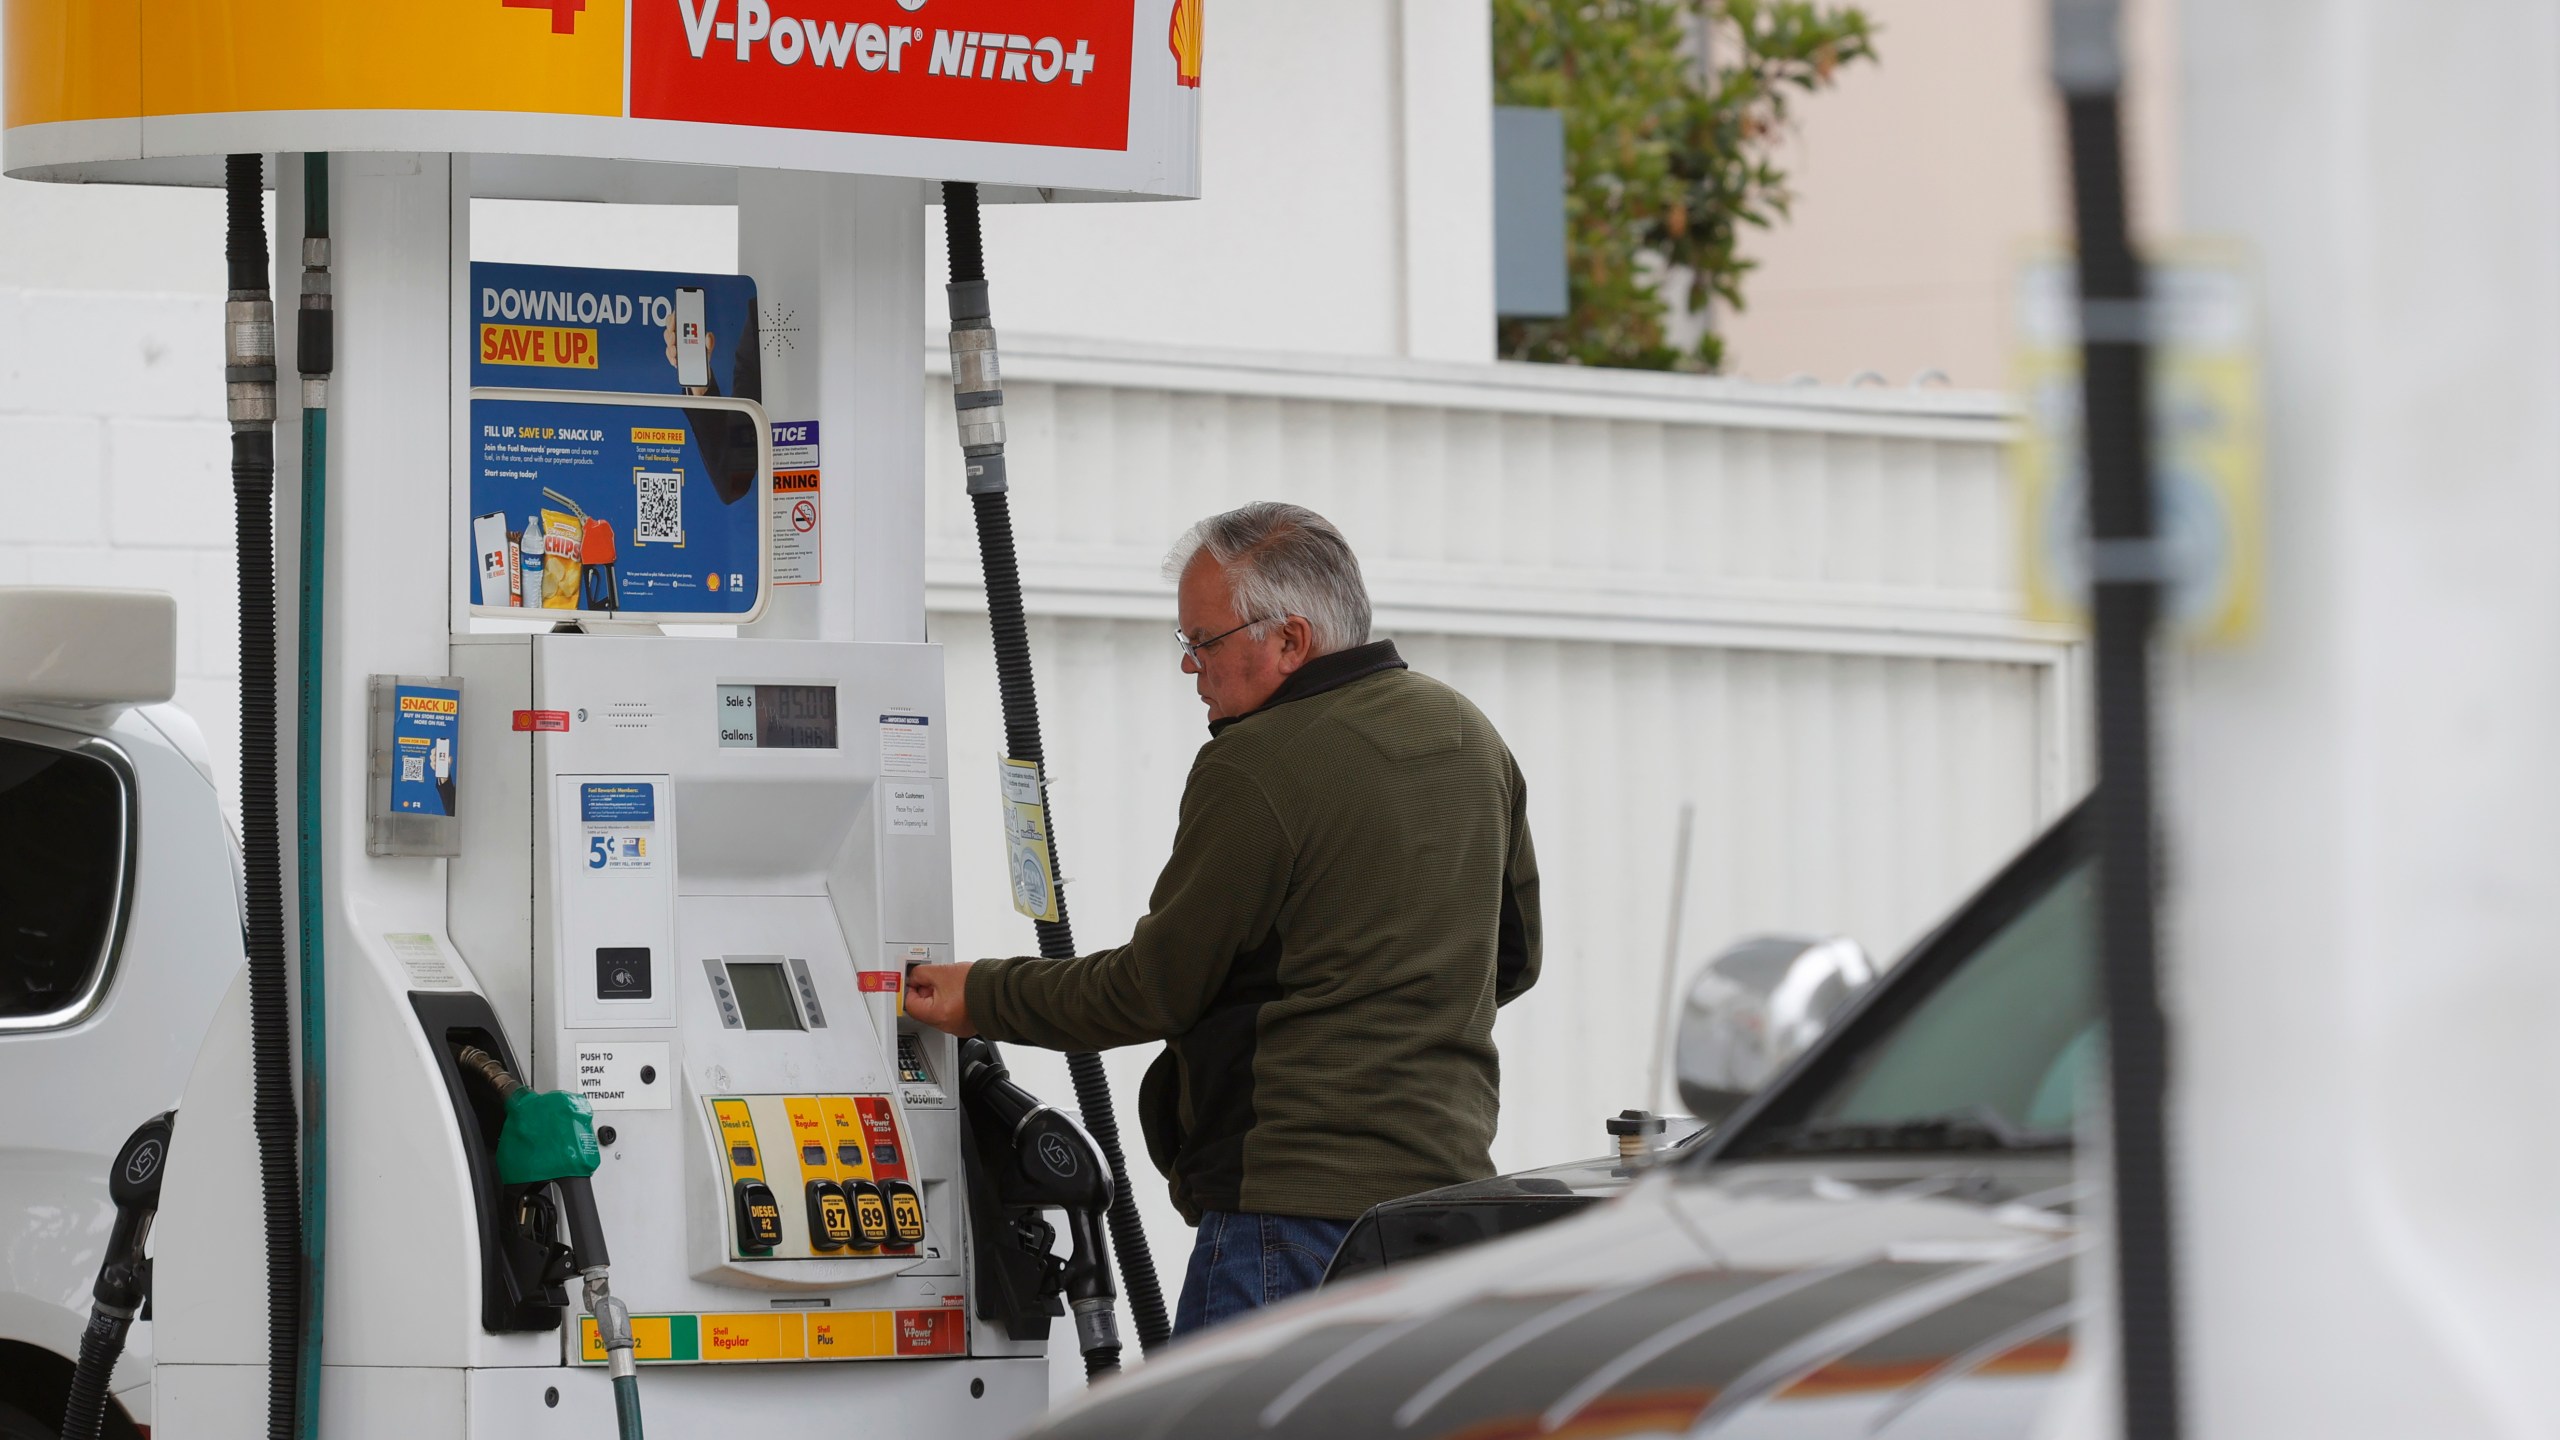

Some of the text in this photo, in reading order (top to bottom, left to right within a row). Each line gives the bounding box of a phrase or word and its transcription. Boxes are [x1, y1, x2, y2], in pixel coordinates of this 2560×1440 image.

[482, 287, 672, 327] DOWNLOAD TO
[483, 327, 595, 366] SAVE UP.
[484, 425, 605, 441] FILL UP. SAVE UP. SNACK UP.
[634, 431, 683, 441] JOIN FOR FREE
[772, 427, 807, 442] TICE
[484, 444, 497, 452] Join
[497, 443, 506, 452] the
[507, 444, 520, 453] Fuel
[546, 447, 571, 456] program
[571, 447, 581, 455] and
[501, 453, 509, 461] the
[533, 455, 544, 463] with
[553, 457, 573, 466] payment
[484, 468, 538, 480] Start saving today!
[773, 474, 818, 490] RNING
[545, 536, 581, 560] CHIPS
[510, 545, 520, 574] CANDY
[511, 573, 521, 590] BAR
[402, 698, 456, 713] SNACK UP.
[726, 695, 752, 709] Sale $
[721, 729, 754, 741] Gallons
[895, 791, 925, 800] Cash Customers
[895, 805, 907, 813] Please
[580, 1053, 613, 1061] PUSH TO
[581, 1066, 605, 1074] SPEAK
[583, 1091, 625, 1099] ATTENDANT
[722, 1120, 741, 1128] Diesel
[795, 1120, 819, 1129] Regular
[864, 1119, 890, 1127] V-Power
[1043, 1138, 1070, 1169] VST
[130, 1147, 156, 1178] VST
[751, 1205, 778, 1218] DIESEL
[861, 1207, 883, 1228] 89
[895, 1207, 919, 1228] 91
[761, 1218, 773, 1231] #2
[825, 1208, 846, 1229] 87
[942, 1296, 964, 1306] Premium
[817, 1325, 831, 1333] Shell
[903, 1318, 915, 1327] Shell
[713, 1327, 729, 1335] Shell
[904, 1327, 932, 1338] V-Power
[713, 1336, 750, 1350] Regular
[817, 1334, 834, 1345] Plus
